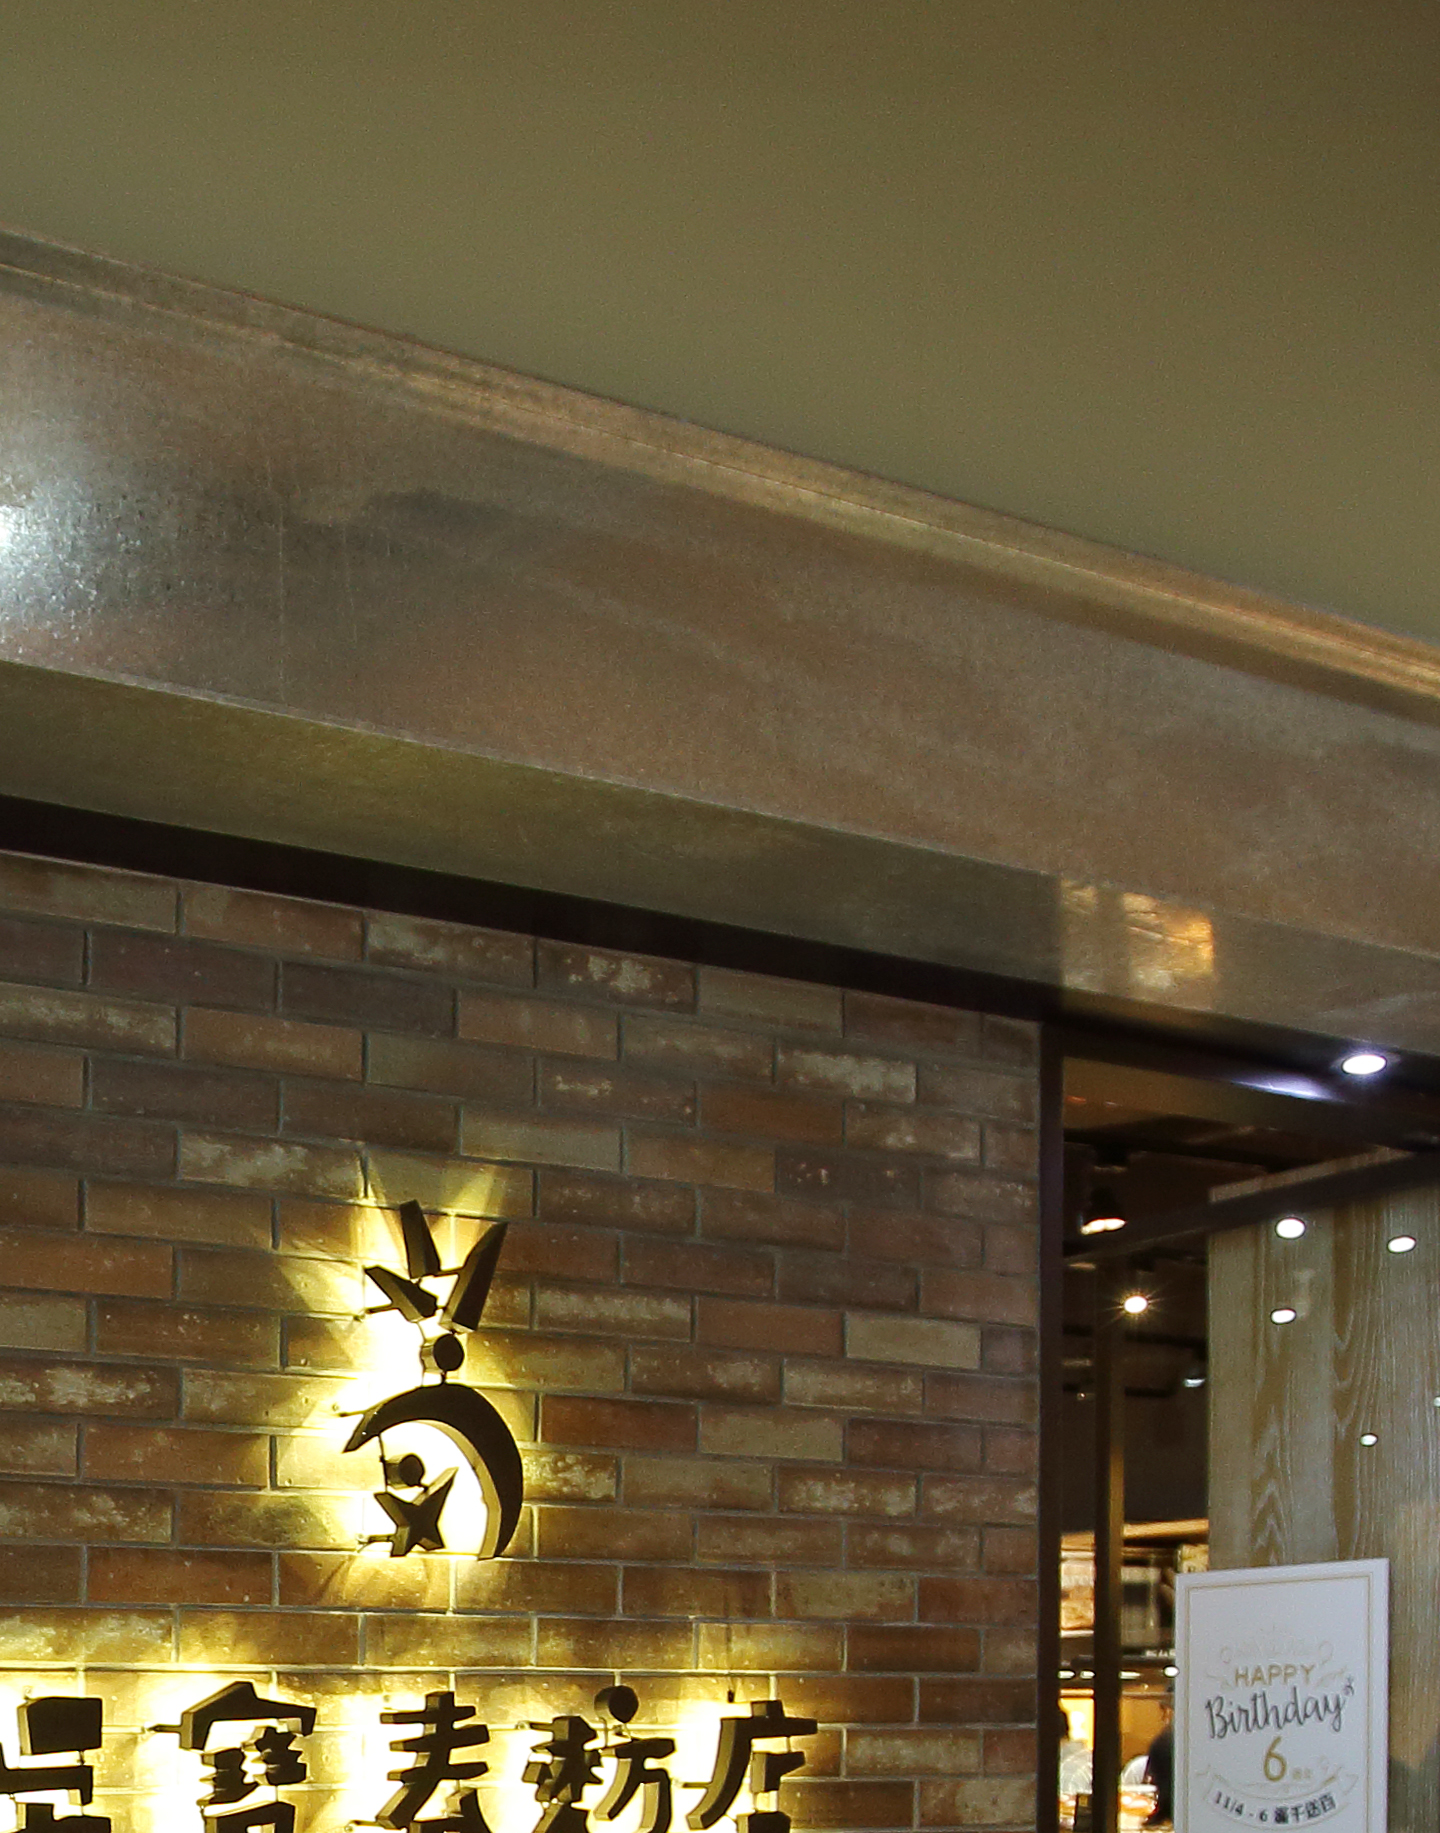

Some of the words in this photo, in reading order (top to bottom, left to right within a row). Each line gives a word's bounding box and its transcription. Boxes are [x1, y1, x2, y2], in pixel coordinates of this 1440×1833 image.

[1234, 1664, 1316, 1688] HAPPY
[1205, 1685, 1347, 1739] Birthday
[1262, 1736, 1288, 1783] 6
[1258, 1808, 1269, 1823] 6
